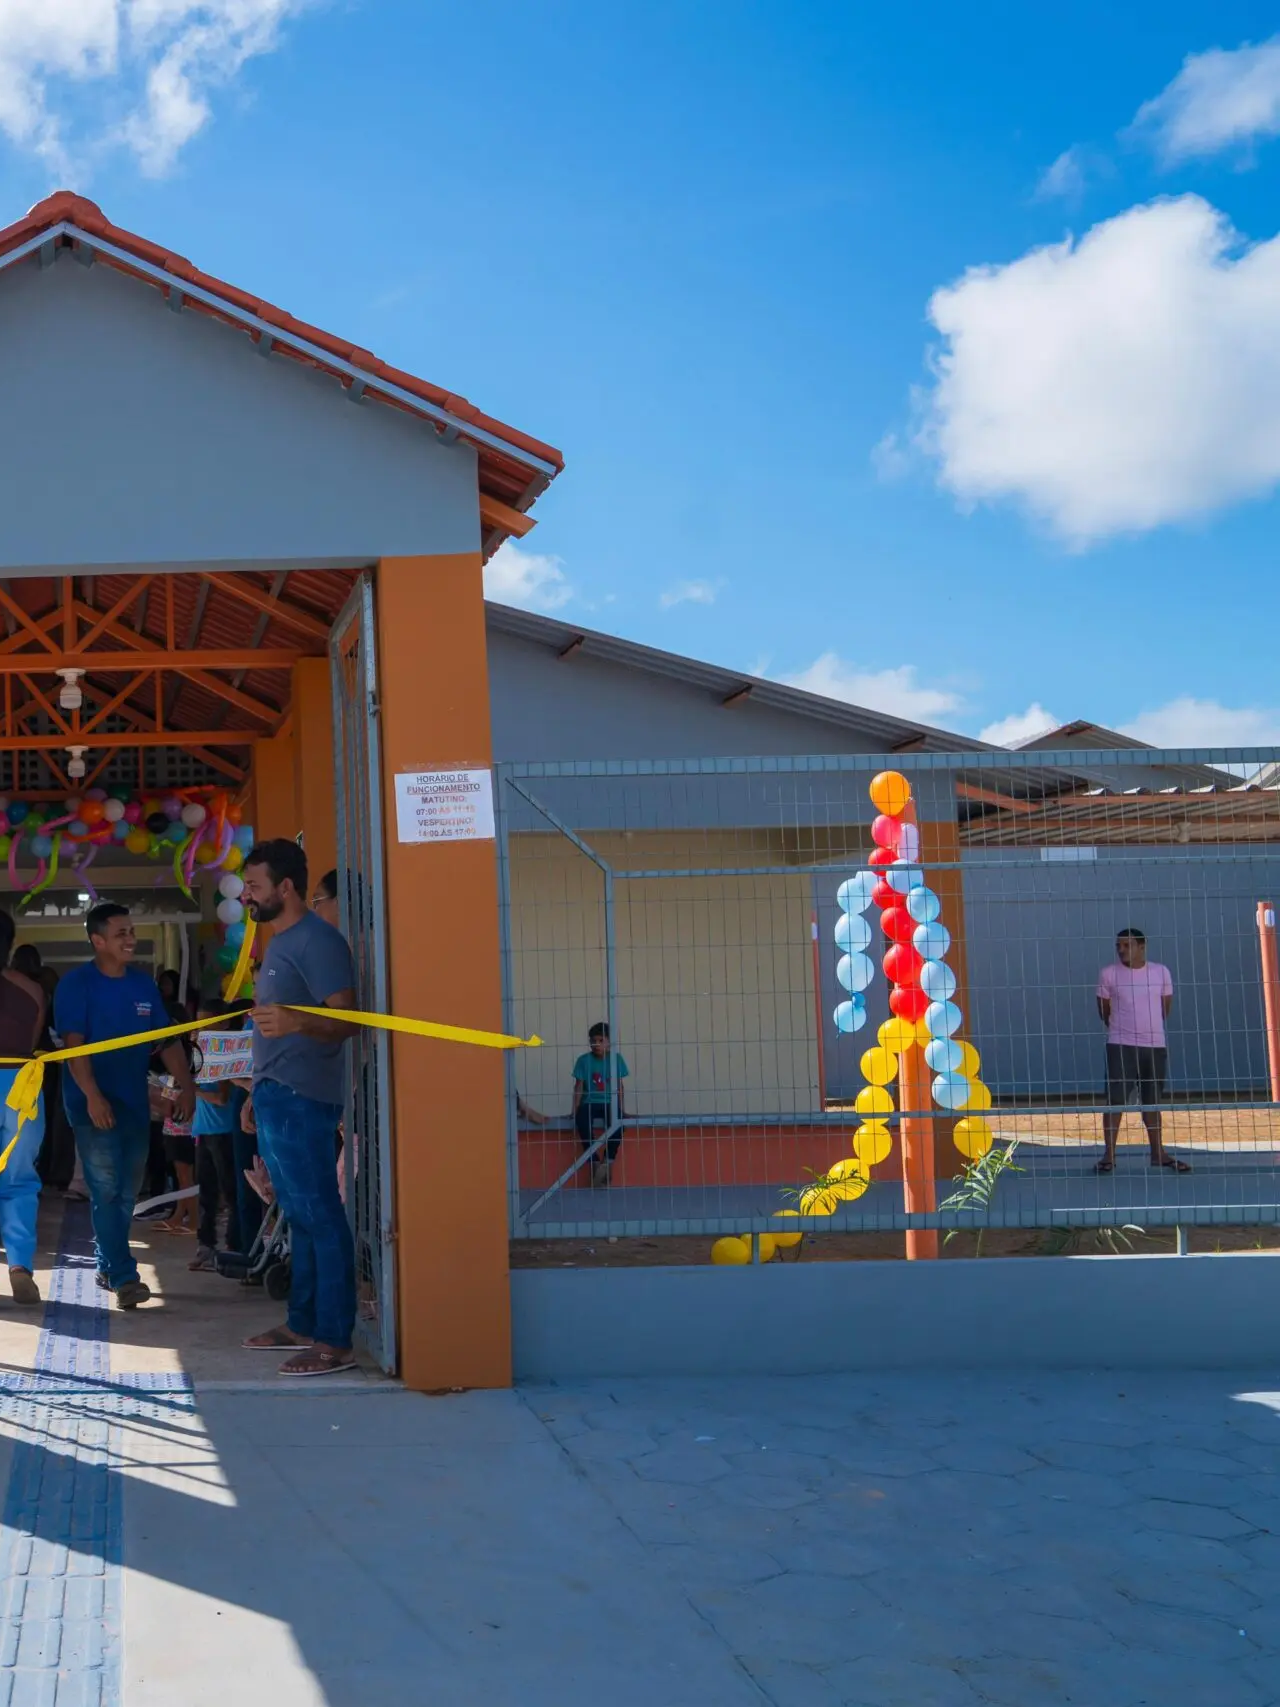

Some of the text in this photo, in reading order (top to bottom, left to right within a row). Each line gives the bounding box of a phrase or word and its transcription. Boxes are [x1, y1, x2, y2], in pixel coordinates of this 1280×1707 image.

[457, 773, 469, 782] DE
[407, 783, 481, 794] FUNCIONAMENTO
[416, 808, 438, 816] 07:00
